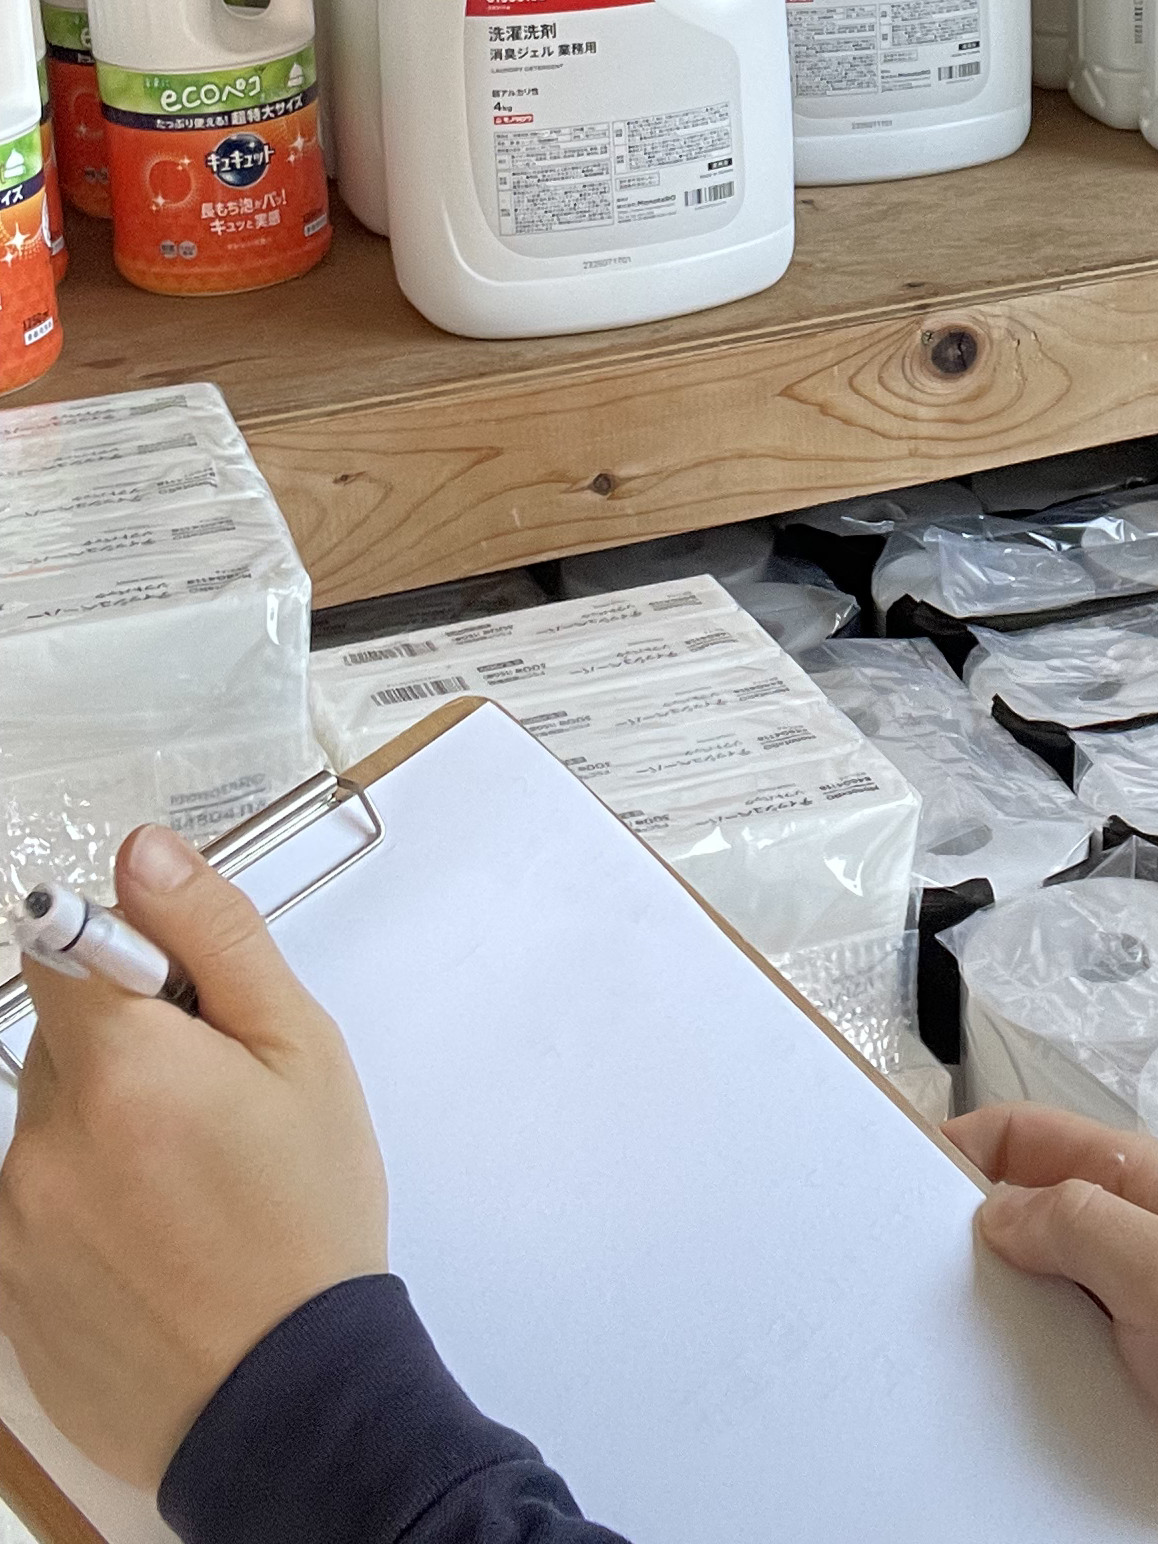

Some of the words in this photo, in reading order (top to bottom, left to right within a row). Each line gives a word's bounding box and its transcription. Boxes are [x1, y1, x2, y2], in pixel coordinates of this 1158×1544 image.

[489, 23, 557, 42] 洗濯洗剤
[490, 46, 554, 61] 消臭ジェル
[558, 41, 597, 57] 業務用
